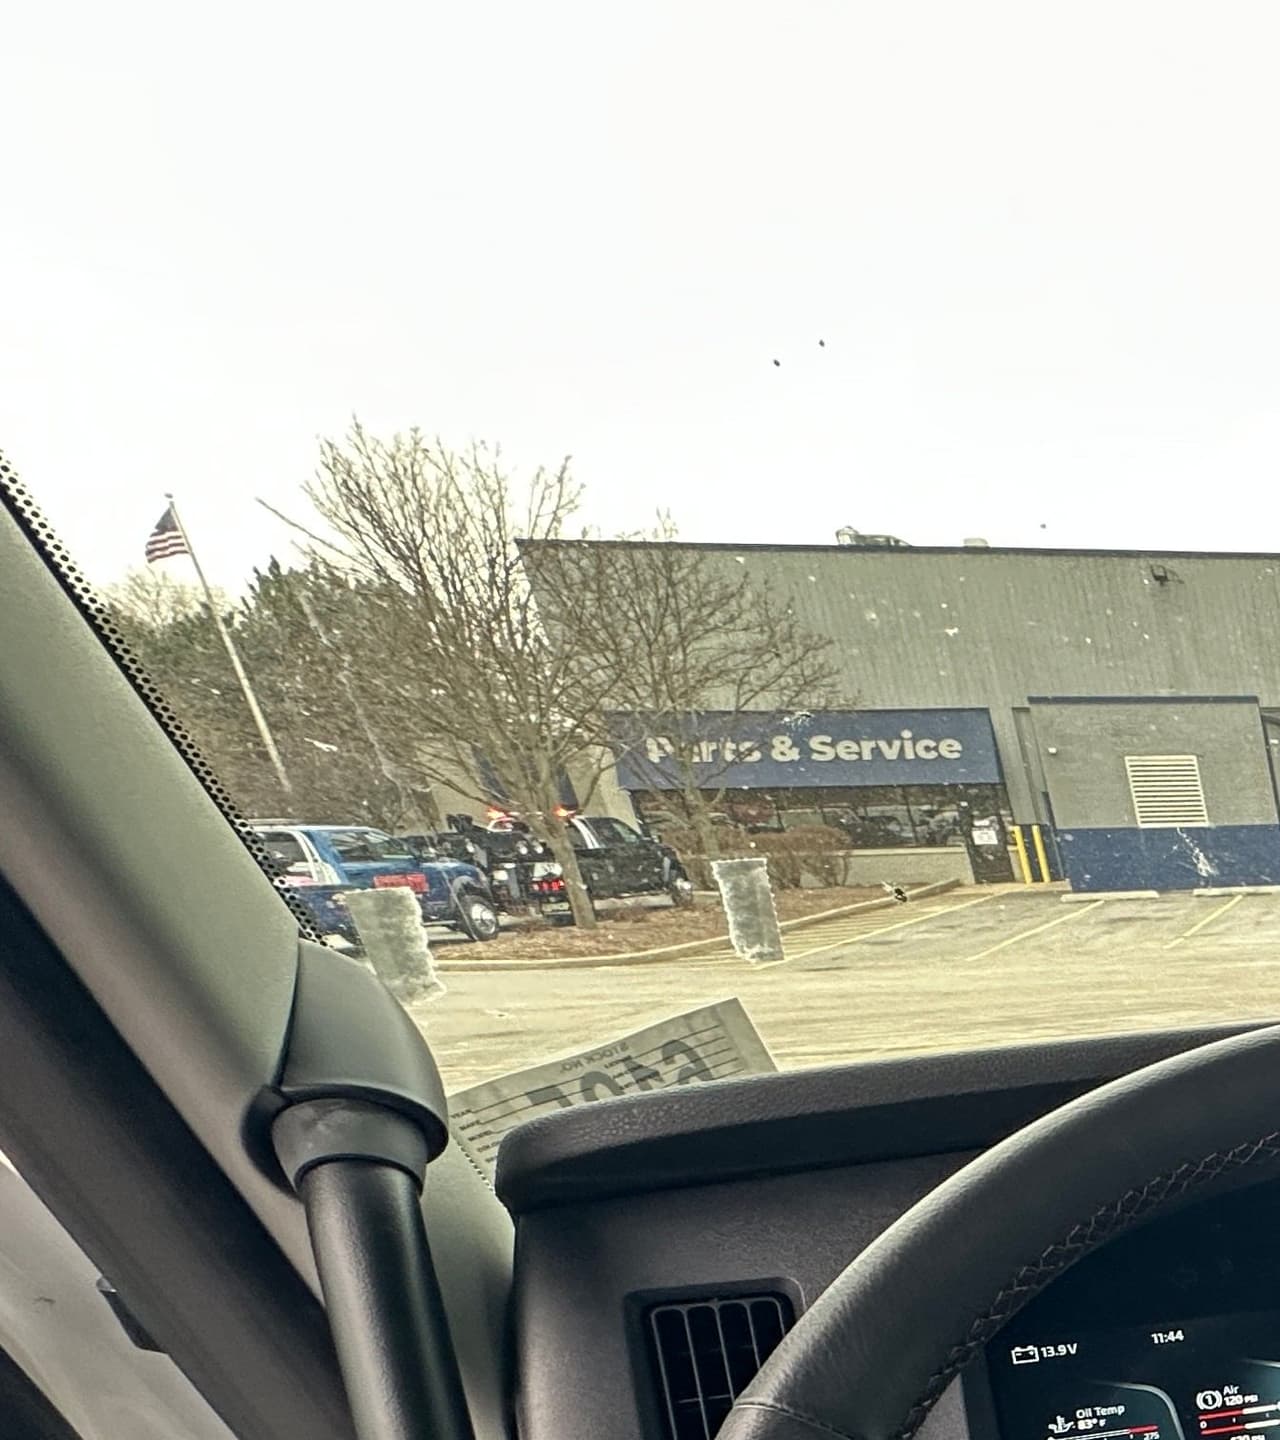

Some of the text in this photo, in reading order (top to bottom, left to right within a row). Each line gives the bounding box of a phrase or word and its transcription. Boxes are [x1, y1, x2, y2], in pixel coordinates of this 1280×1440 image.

[771, 736, 801, 762] &
[809, 730, 963, 762] Service
[1151, 1330, 1184, 1344] 11:44
[1223, 1384, 1239, 1395] Air
[1224, 1395, 1243, 1406] 120
[1076, 1405, 1125, 1419] Oil Temp
